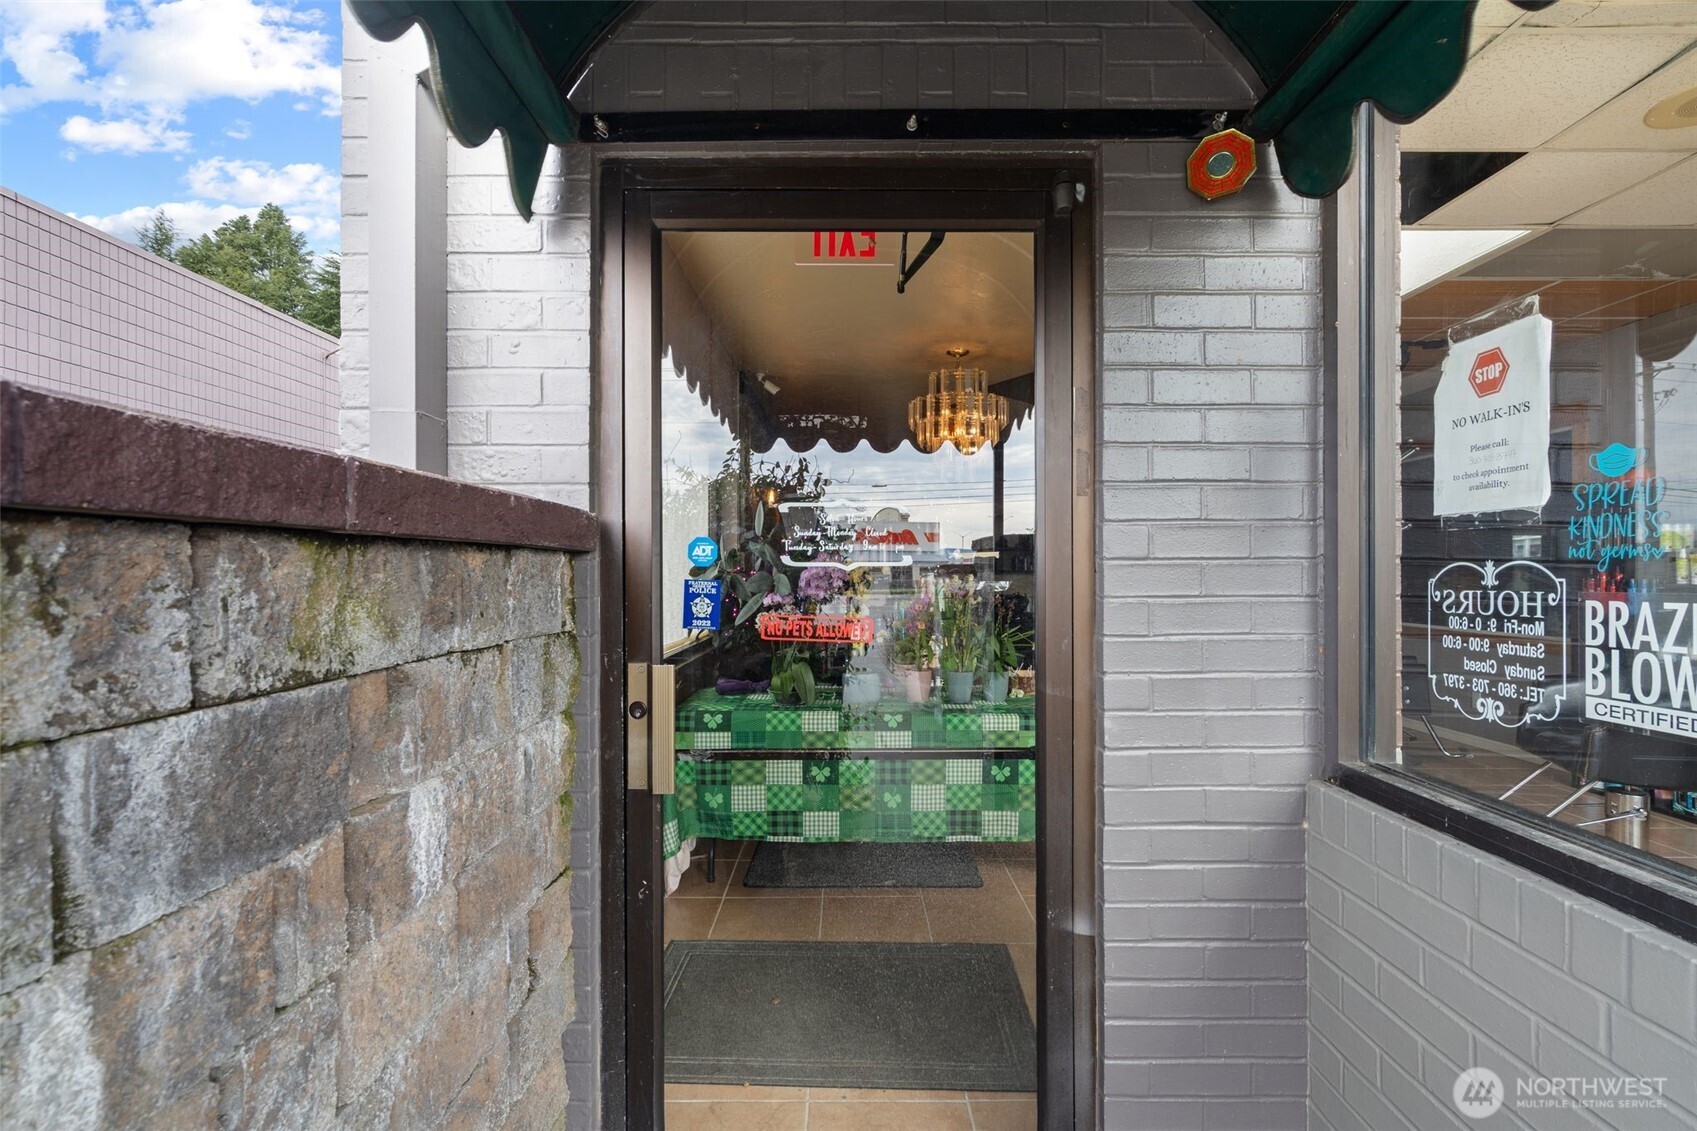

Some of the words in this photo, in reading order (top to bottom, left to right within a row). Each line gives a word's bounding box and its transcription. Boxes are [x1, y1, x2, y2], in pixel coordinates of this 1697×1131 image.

[1475, 362, 1503, 384] STOP
[1451, 416, 1467, 430] NO
[1469, 400, 1531, 424] WALK-IN'S
[1470, 443, 1491, 453] Please
[1492, 438, 1510, 448] call:
[1461, 469, 1480, 479] check
[1480, 463, 1529, 479] appointment
[1468, 479, 1510, 492] availability.
[1573, 476, 1665, 512] SPREAD
[1568, 509, 1669, 540] KINDNESS
[691, 545, 715, 557] ADT
[1568, 538, 1595, 560] not
[1597, 543, 1652, 573] germs
[692, 619, 712, 627] 2022
[767, 621, 782, 636] NO
[786, 620, 813, 636] PETS
[816, 621, 867, 640] ALLOWED
